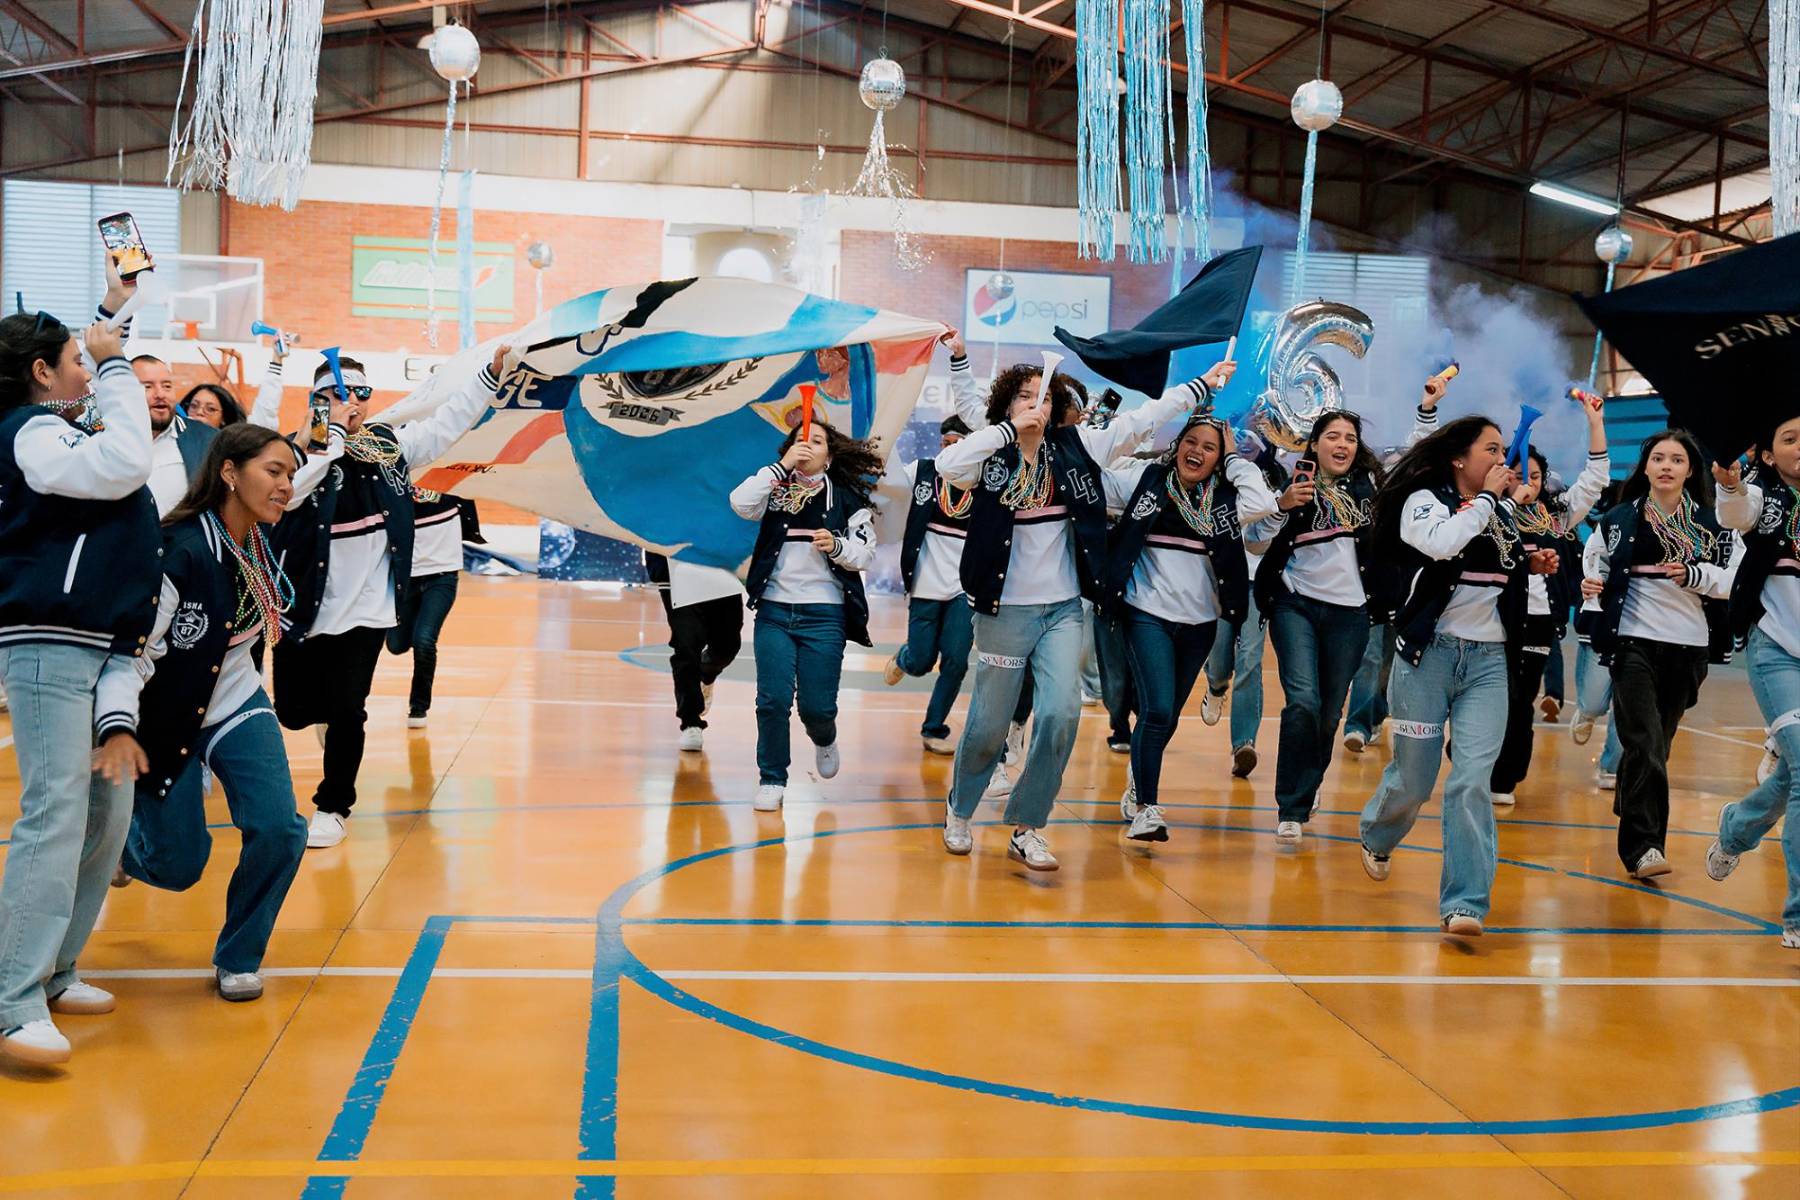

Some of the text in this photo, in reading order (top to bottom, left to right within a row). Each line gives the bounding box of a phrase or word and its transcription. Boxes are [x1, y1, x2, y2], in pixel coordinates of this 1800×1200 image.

[1021, 298, 1088, 323] pepsi
[1694, 313, 1800, 359] SENI
[180, 625, 193, 636] 87
